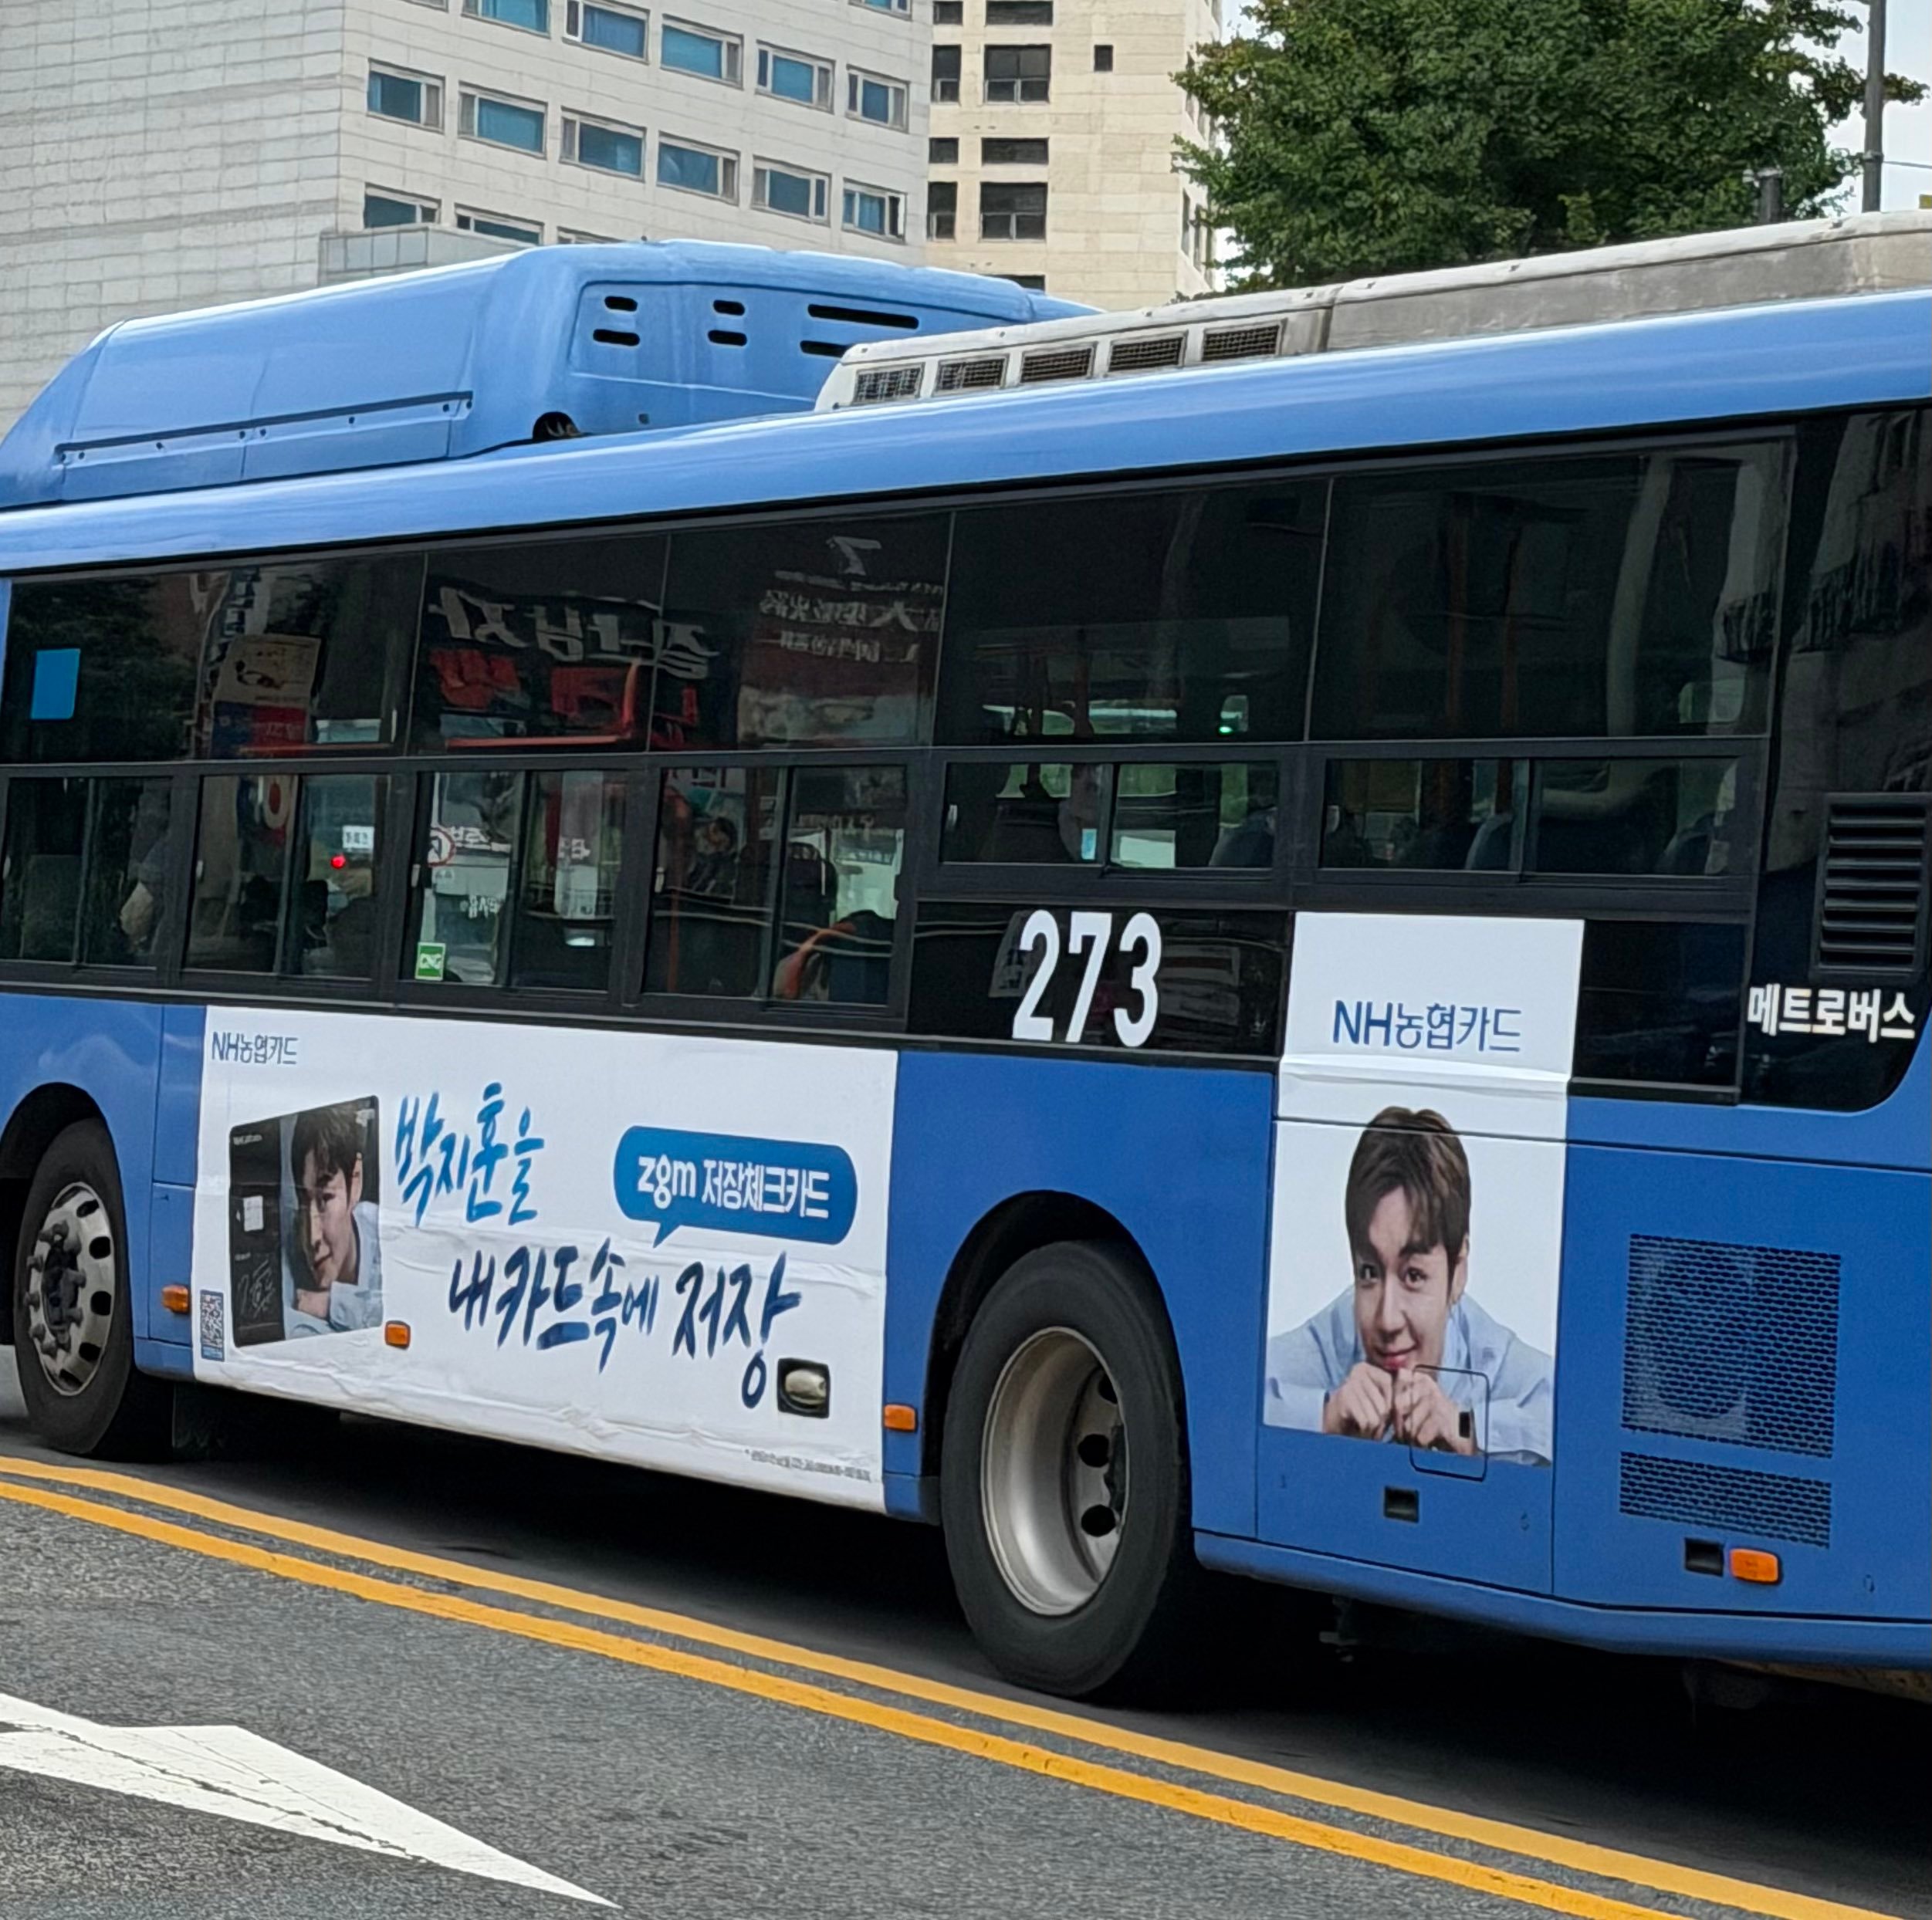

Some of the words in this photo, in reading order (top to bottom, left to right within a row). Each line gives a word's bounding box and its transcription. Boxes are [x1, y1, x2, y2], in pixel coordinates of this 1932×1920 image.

[1012, 909, 1162, 1048] 273
[1332, 999, 1522, 1053] NH농협카드
[1747, 983, 1915, 1043] 메트로버스
[211, 1031, 299, 1065] NH농협카드
[394, 1082, 544, 1229] 박지훈을
[637, 1154, 696, 1209] zgm
[701, 1158, 831, 1219] 저장체크카드
[672, 1251, 803, 1409] 저장
